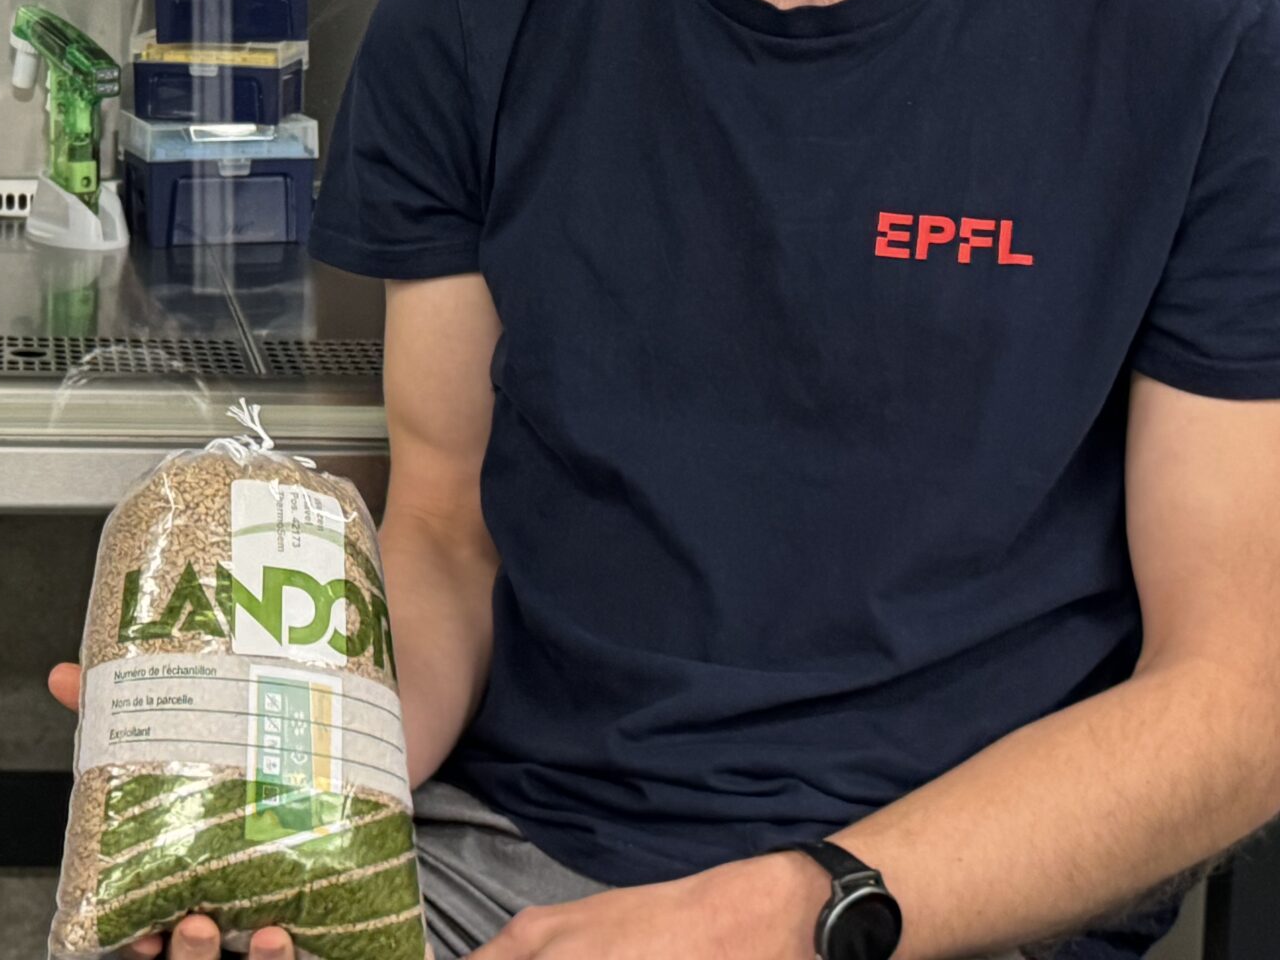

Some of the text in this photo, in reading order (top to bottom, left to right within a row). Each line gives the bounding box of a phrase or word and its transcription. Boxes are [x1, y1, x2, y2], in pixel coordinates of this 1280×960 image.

[875, 211, 1034, 266] EPFL
[114, 663, 217, 680] Numéro de l'échantillon
[133, 696, 144, 707] de
[146, 695, 154, 705] la
[156, 694, 194, 707] parcelle
[109, 726, 151, 741] Exploitant
